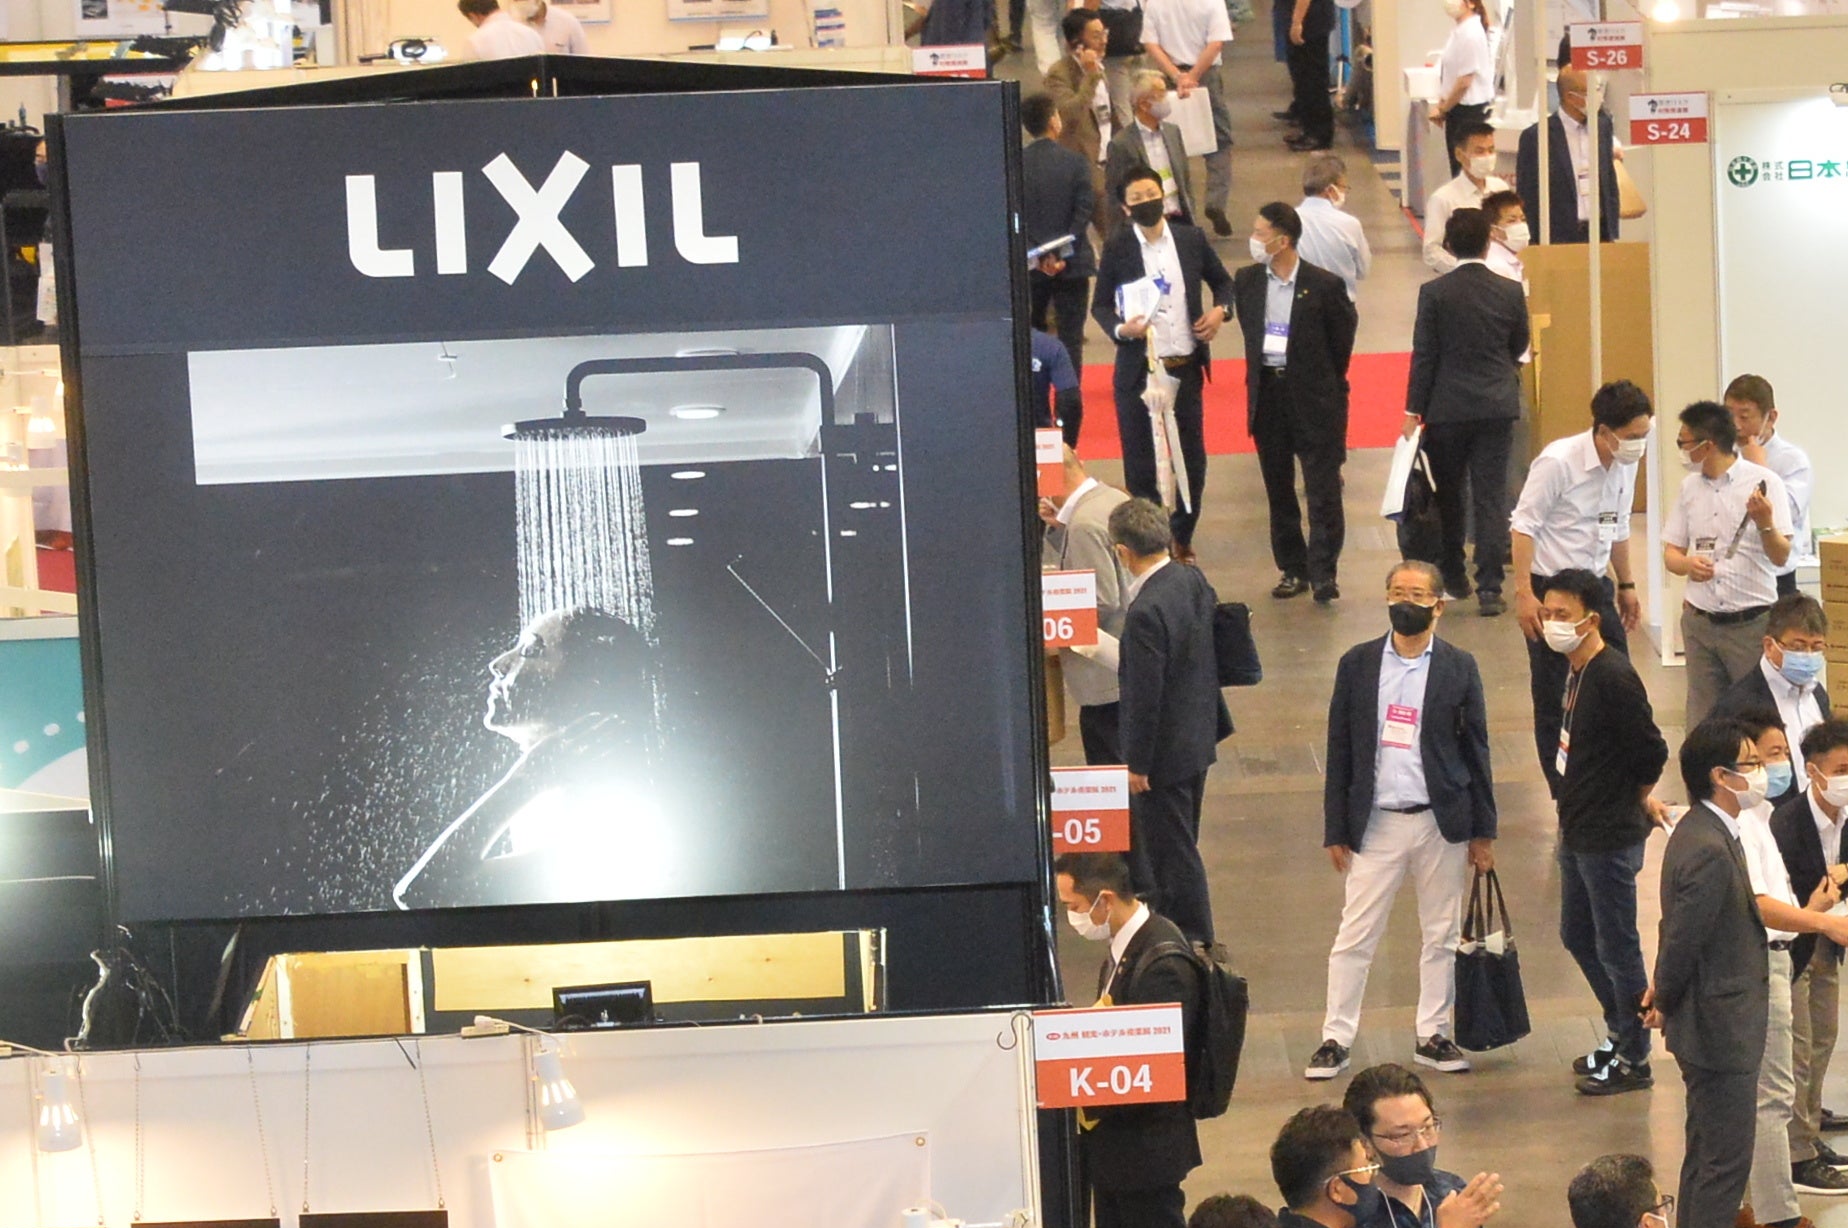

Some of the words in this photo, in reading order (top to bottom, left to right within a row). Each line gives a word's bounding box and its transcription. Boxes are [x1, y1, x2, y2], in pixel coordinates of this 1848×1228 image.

[1587, 49, 1628, 66] S-26
[1647, 123, 1691, 140] S-24
[345, 150, 740, 286] LIXIL
[1153, 1026, 1171, 1035] 2021
[1069, 1064, 1153, 1098] K-04
